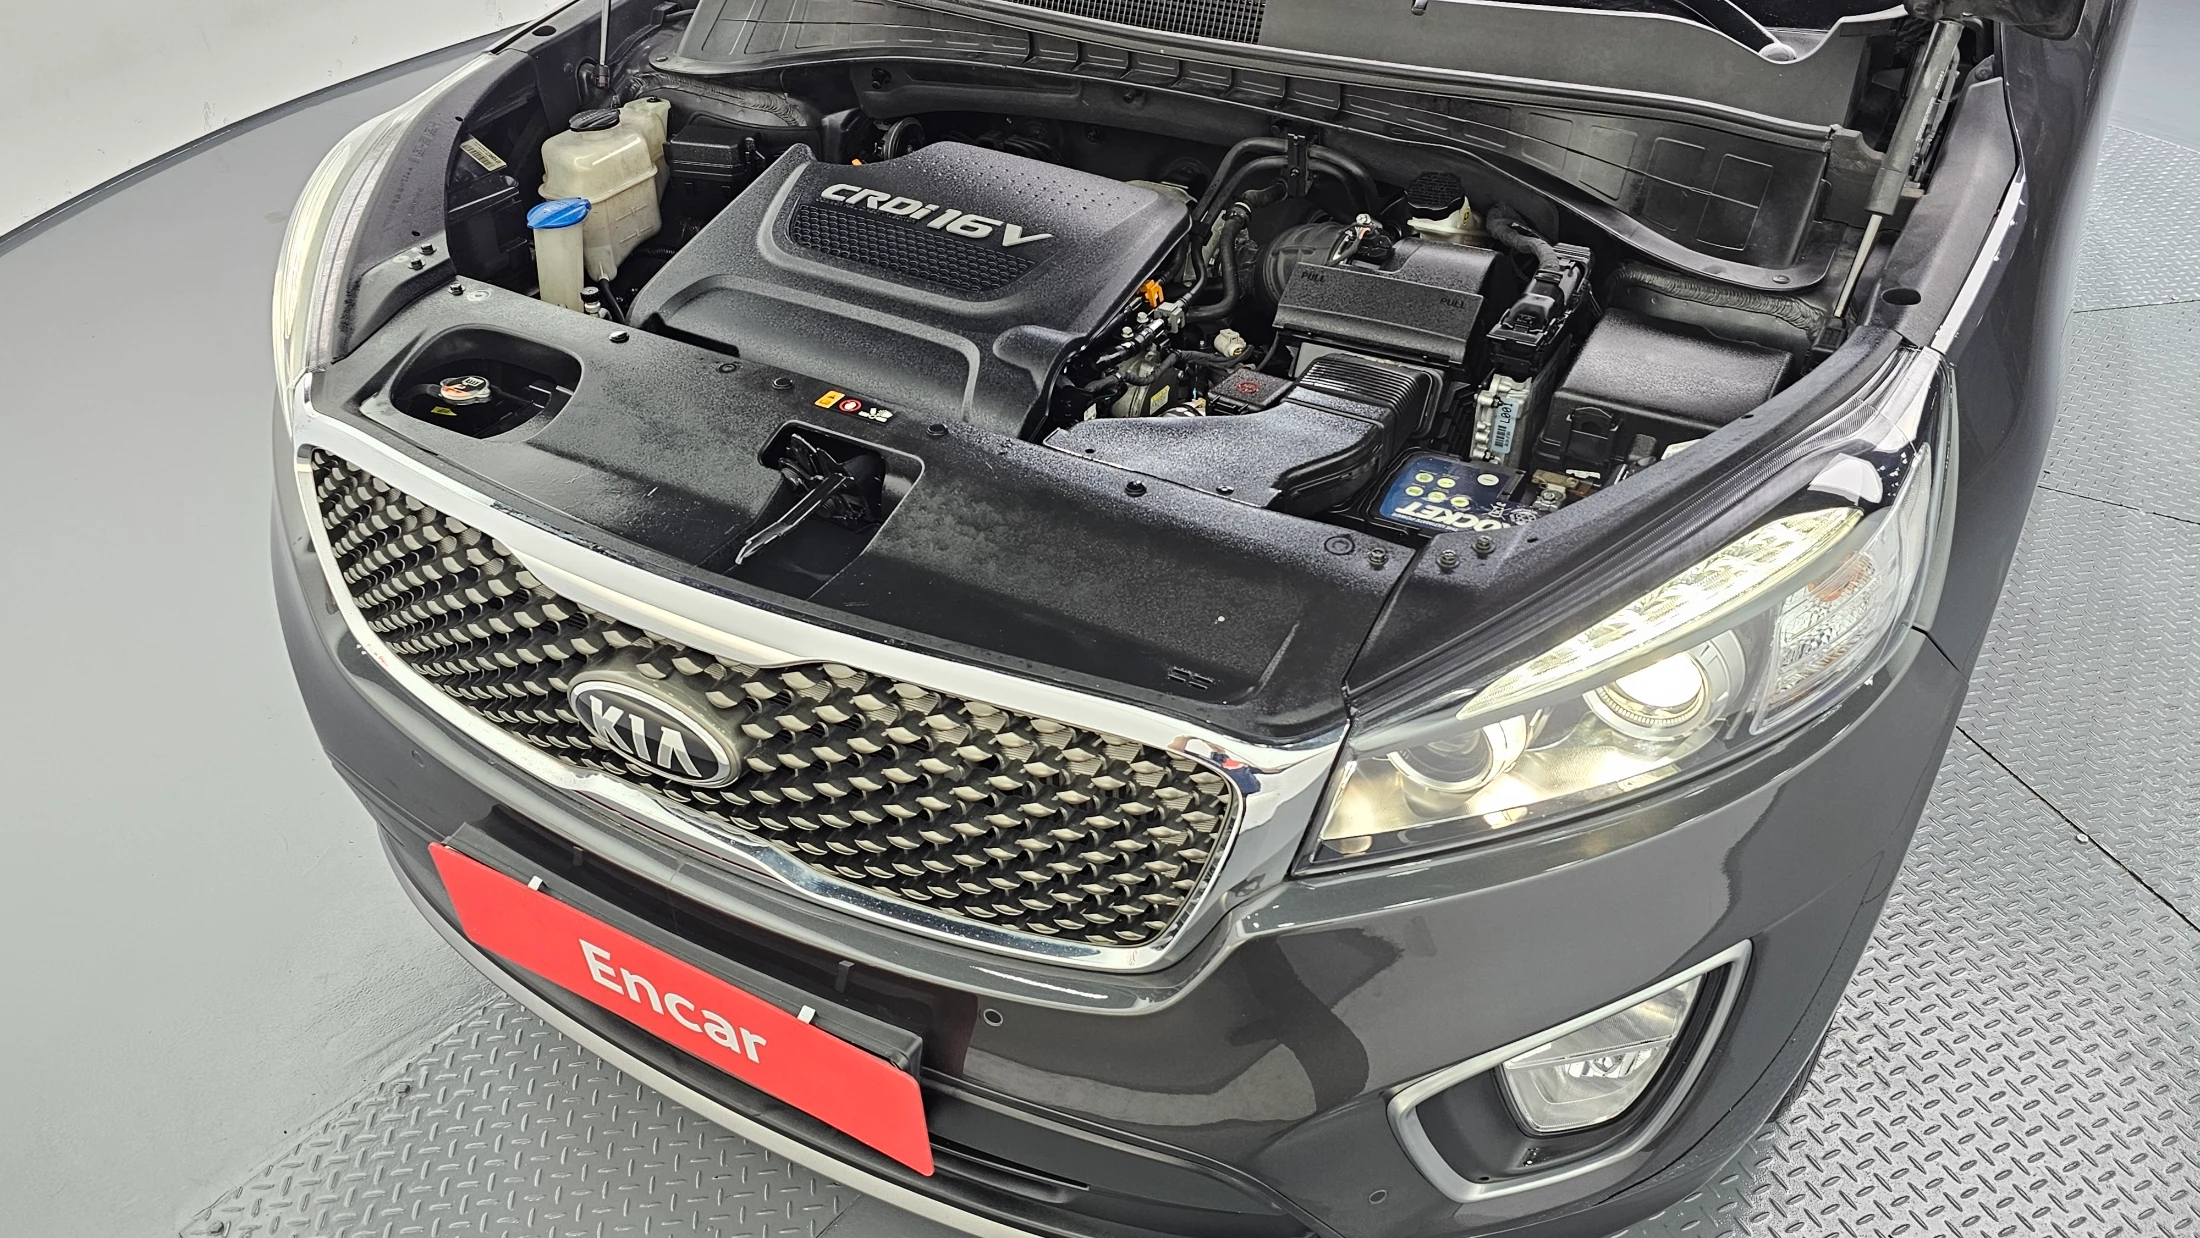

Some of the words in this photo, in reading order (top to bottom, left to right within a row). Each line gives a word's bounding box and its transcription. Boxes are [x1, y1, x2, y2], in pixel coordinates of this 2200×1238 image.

[821, 184, 939, 219] CRDi
[1301, 272, 1325, 283] PULL
[1440, 298, 1466, 309] PULL
[1395, 501, 1511, 532] OCKET
[590, 695, 702, 777] KIA
[578, 938, 767, 1064] Encar
